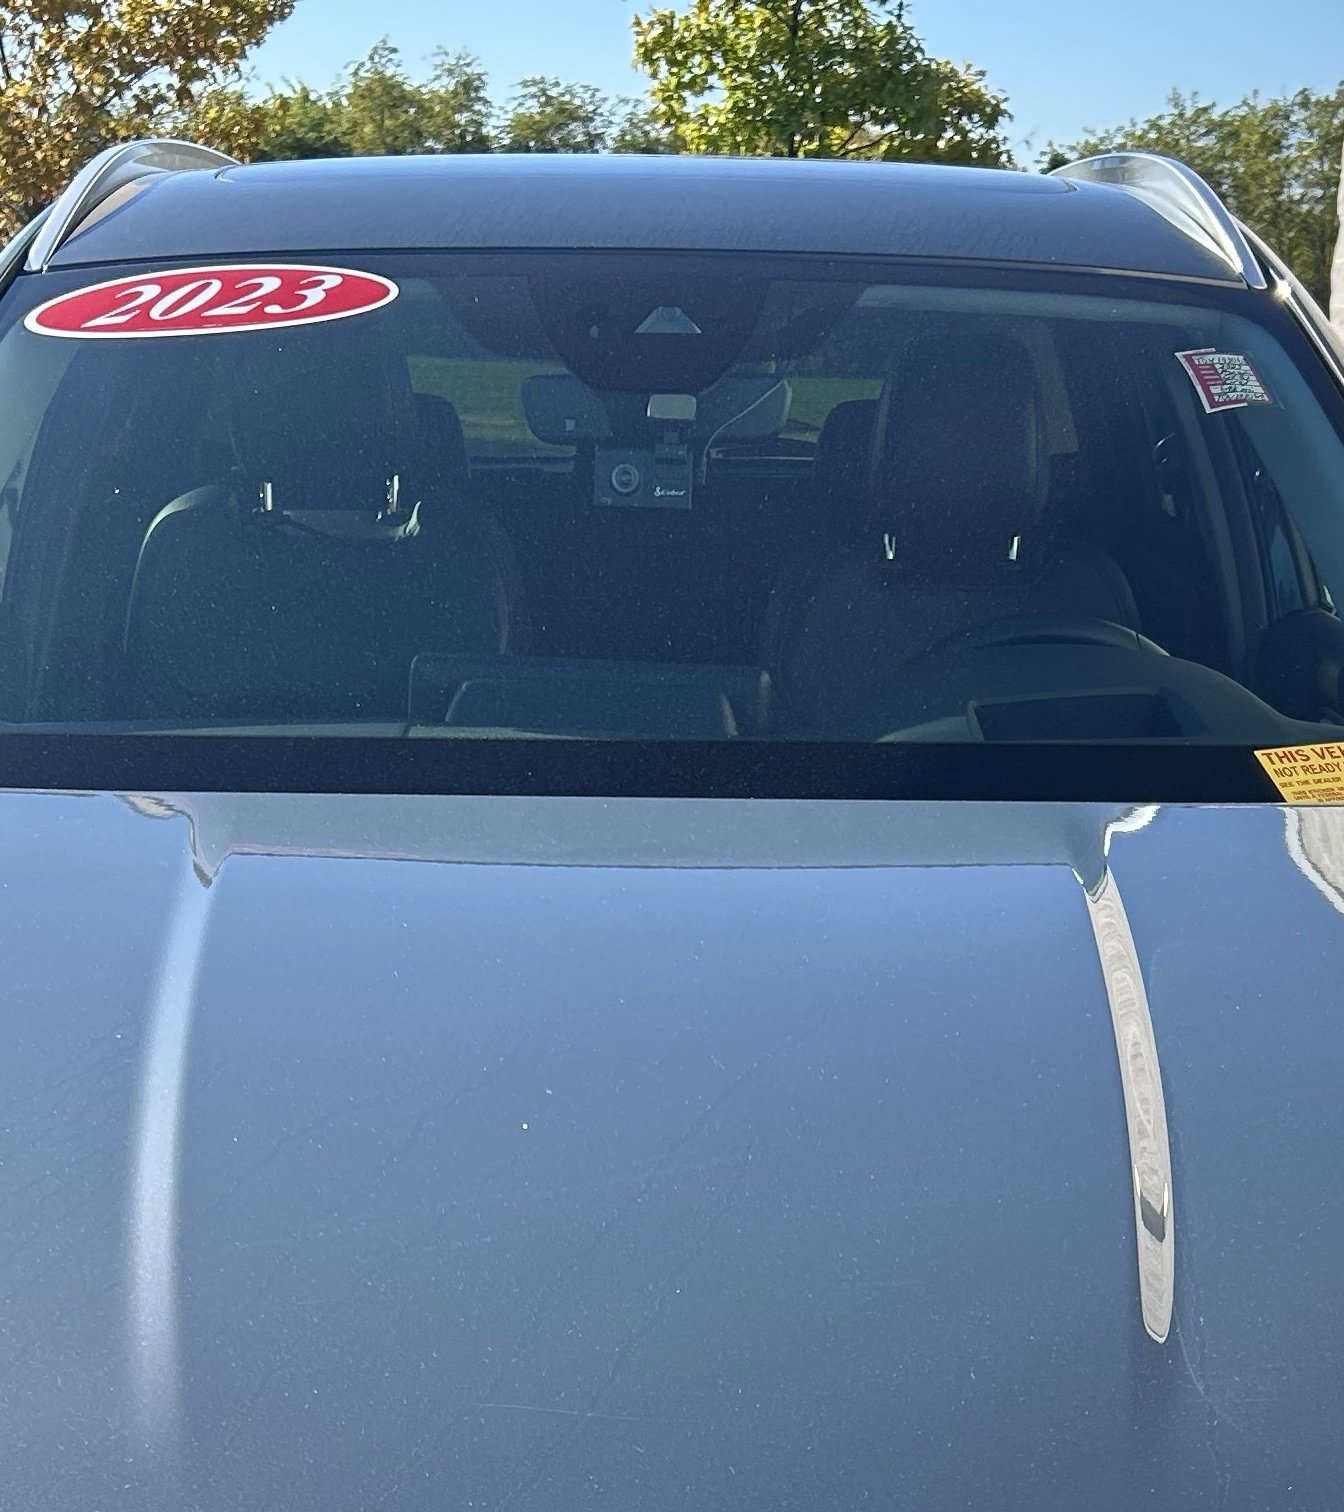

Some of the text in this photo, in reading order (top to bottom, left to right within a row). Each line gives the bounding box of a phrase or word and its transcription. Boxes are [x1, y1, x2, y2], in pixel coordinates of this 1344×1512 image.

[80, 274, 343, 329] 2023
[1260, 749, 1311, 766] THIS
[1272, 765, 1300, 779] NOT
[1299, 761, 1343, 776] READY
